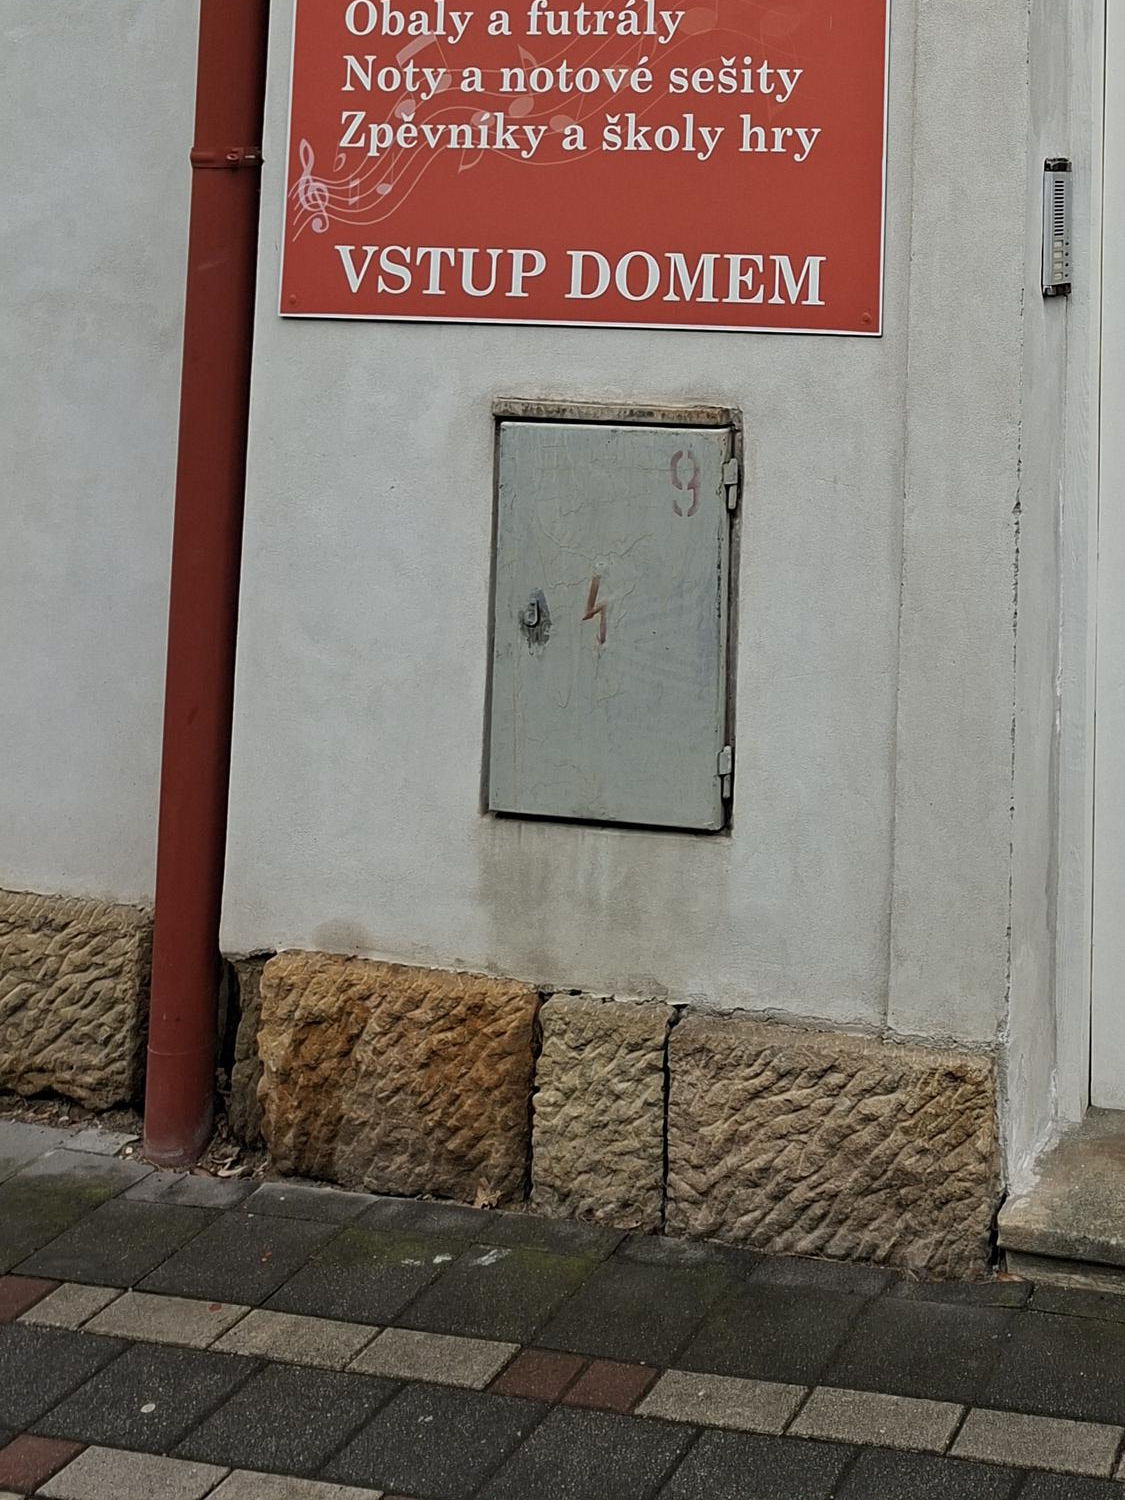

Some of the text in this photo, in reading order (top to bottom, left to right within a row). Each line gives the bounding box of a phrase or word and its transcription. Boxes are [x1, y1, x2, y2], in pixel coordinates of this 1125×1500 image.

[487, 10, 513, 36] a
[341, 55, 804, 103] Noty a notové sešity
[338, 111, 822, 162] Zpěvníky a školy hry
[334, 245, 827, 306] VSTUP DOMEM
[669, 450, 700, 517] 9
